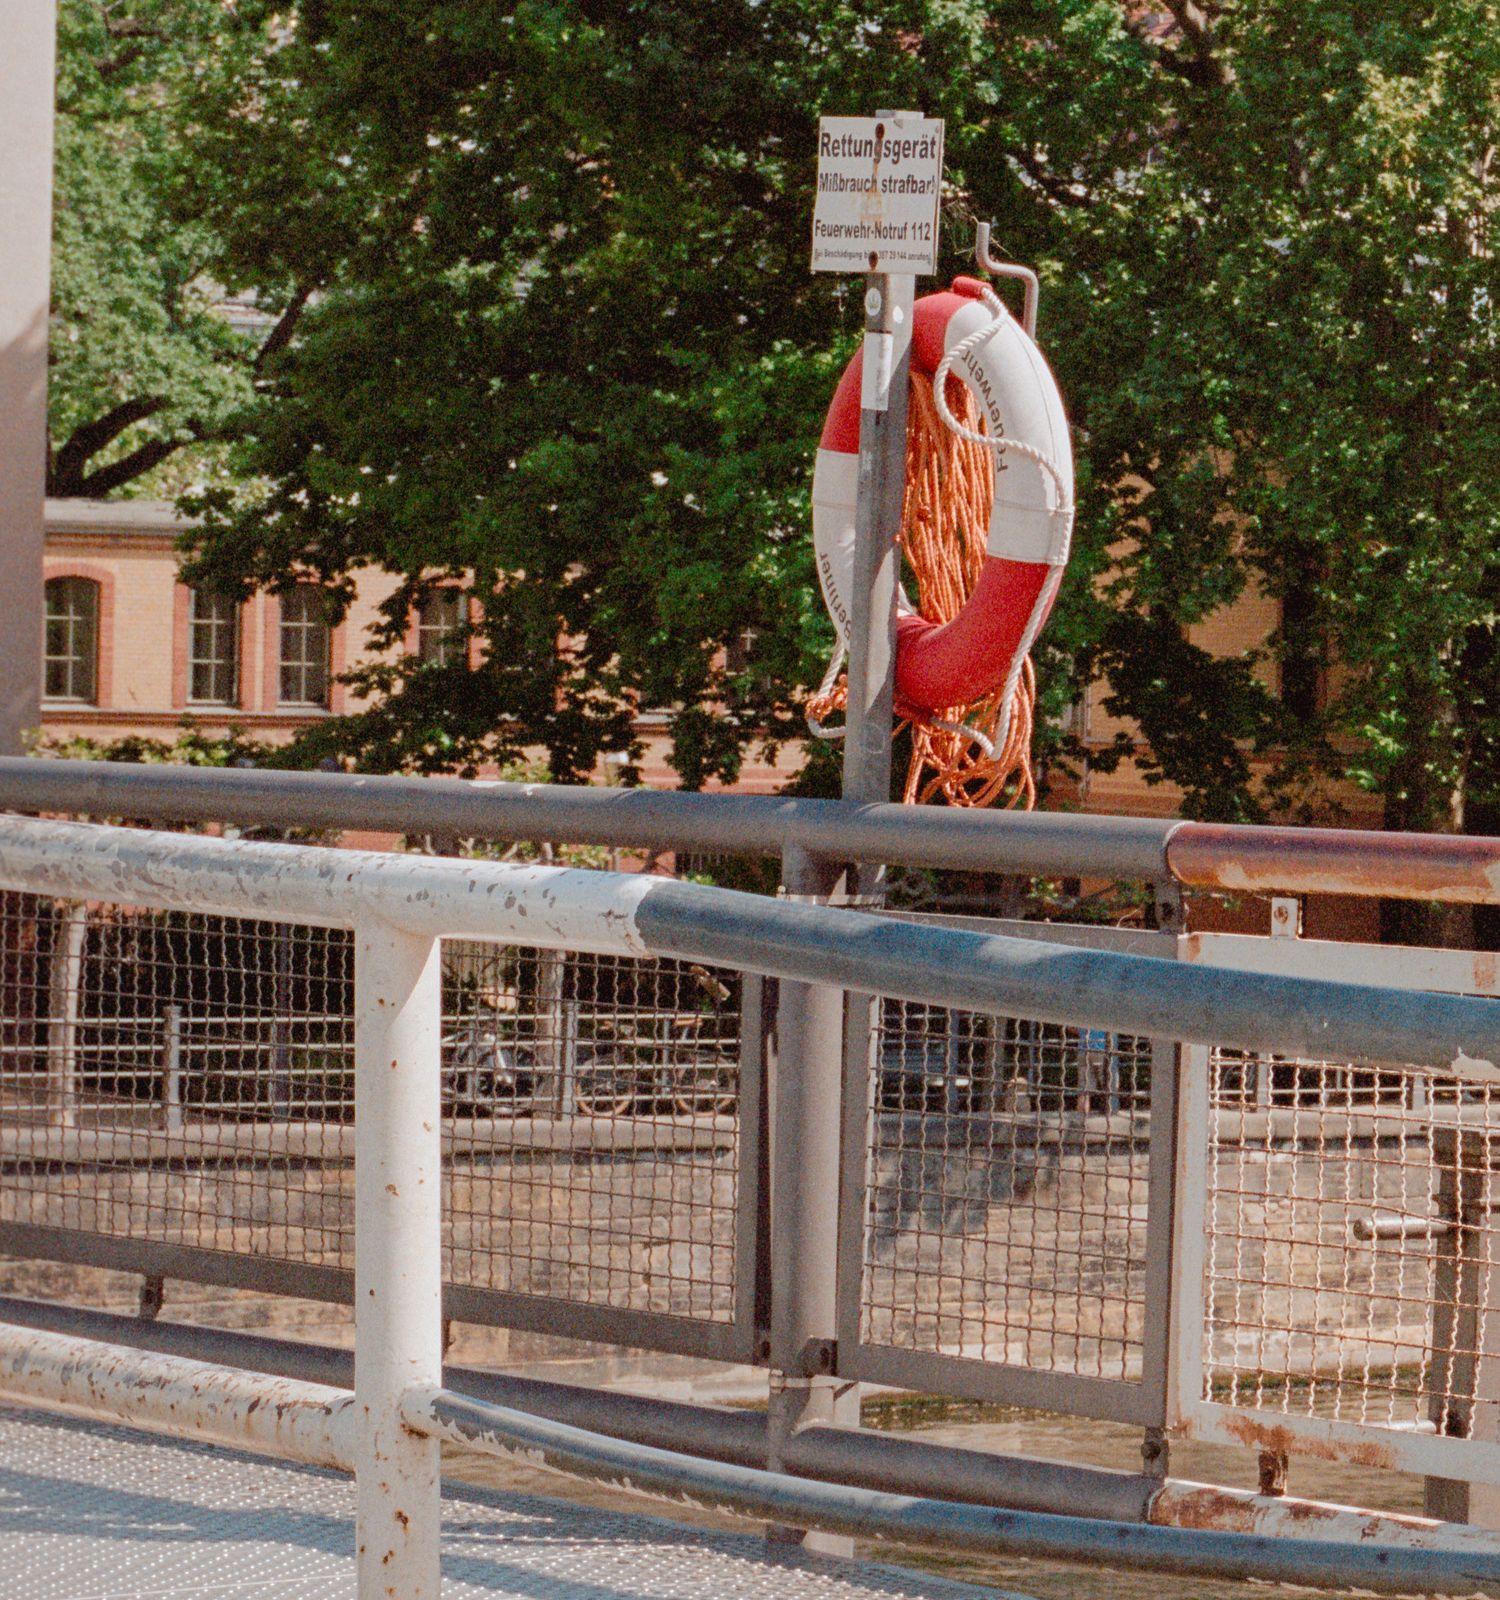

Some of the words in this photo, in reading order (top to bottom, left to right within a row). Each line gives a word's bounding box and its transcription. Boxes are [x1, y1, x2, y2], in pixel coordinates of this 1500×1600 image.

[820, 132, 937, 165] Rettungsgerät
[818, 172, 878, 193] Mißbrauch
[815, 219, 908, 241] Feuerwehr-Notruf
[911, 222, 931, 241] 112
[820, 552, 852, 641] Berliner
